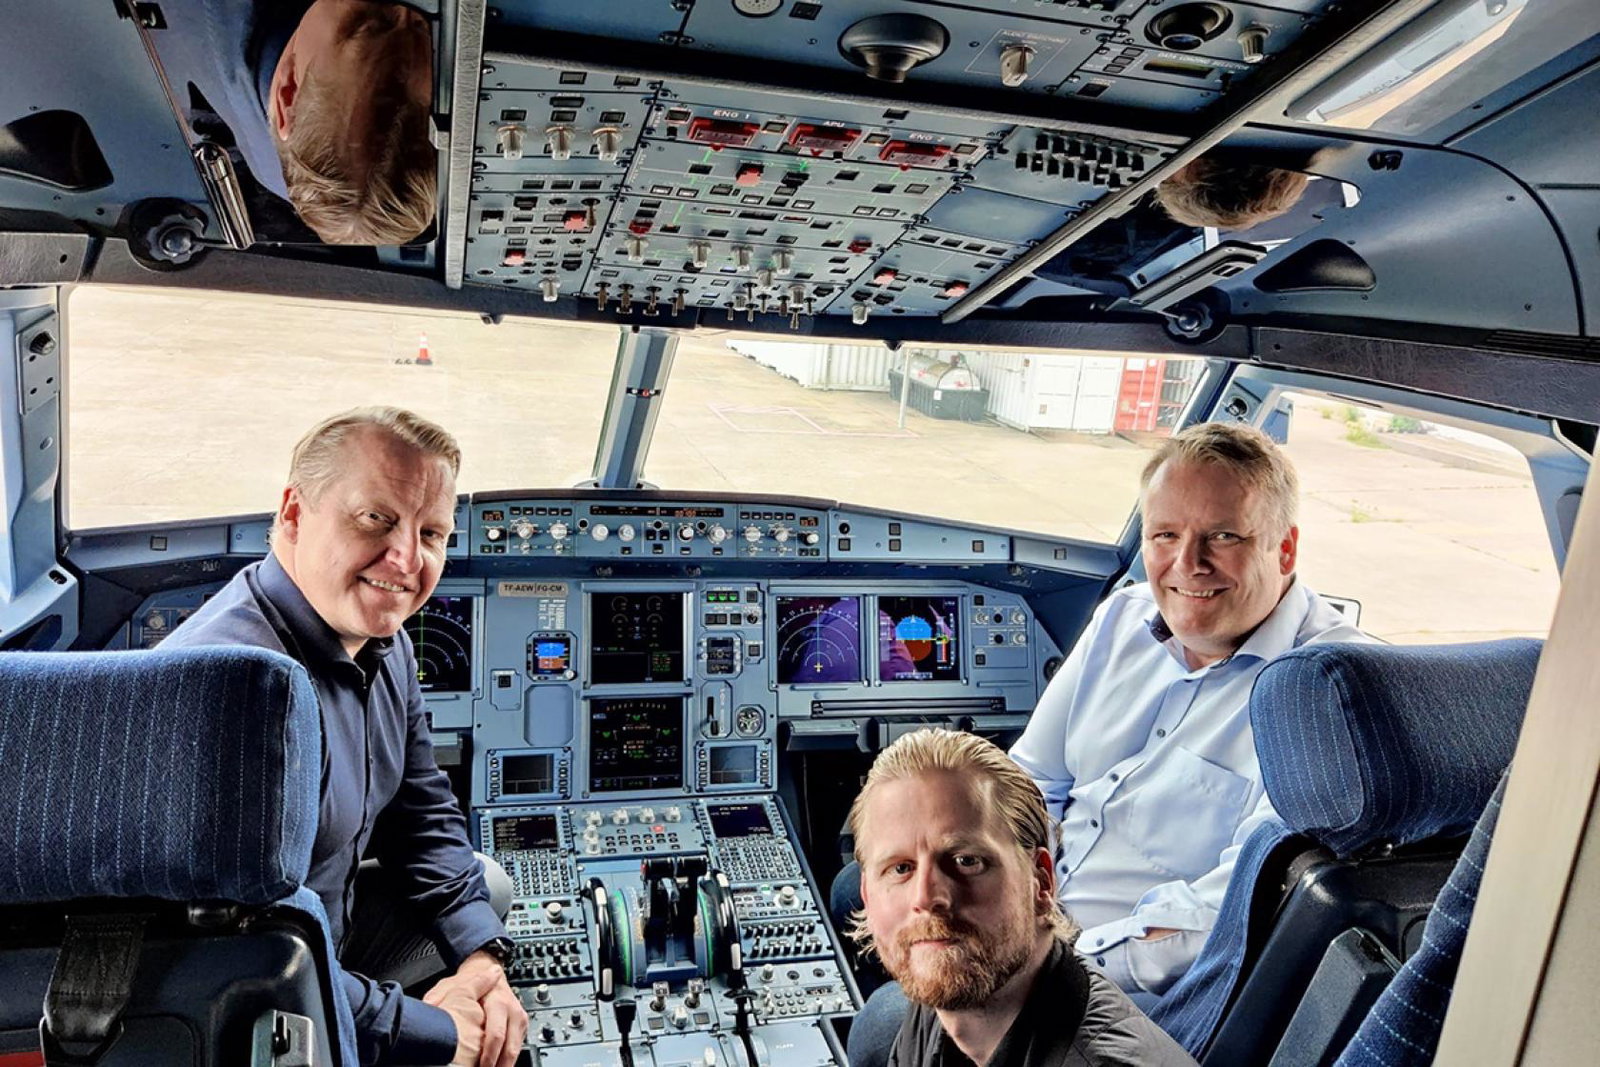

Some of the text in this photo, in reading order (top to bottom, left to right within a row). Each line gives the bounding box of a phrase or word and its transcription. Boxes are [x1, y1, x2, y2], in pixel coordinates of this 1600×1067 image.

[713, 109, 740, 118] ENG
[822, 120, 846, 128] APU
[909, 132, 933, 141] ENG
